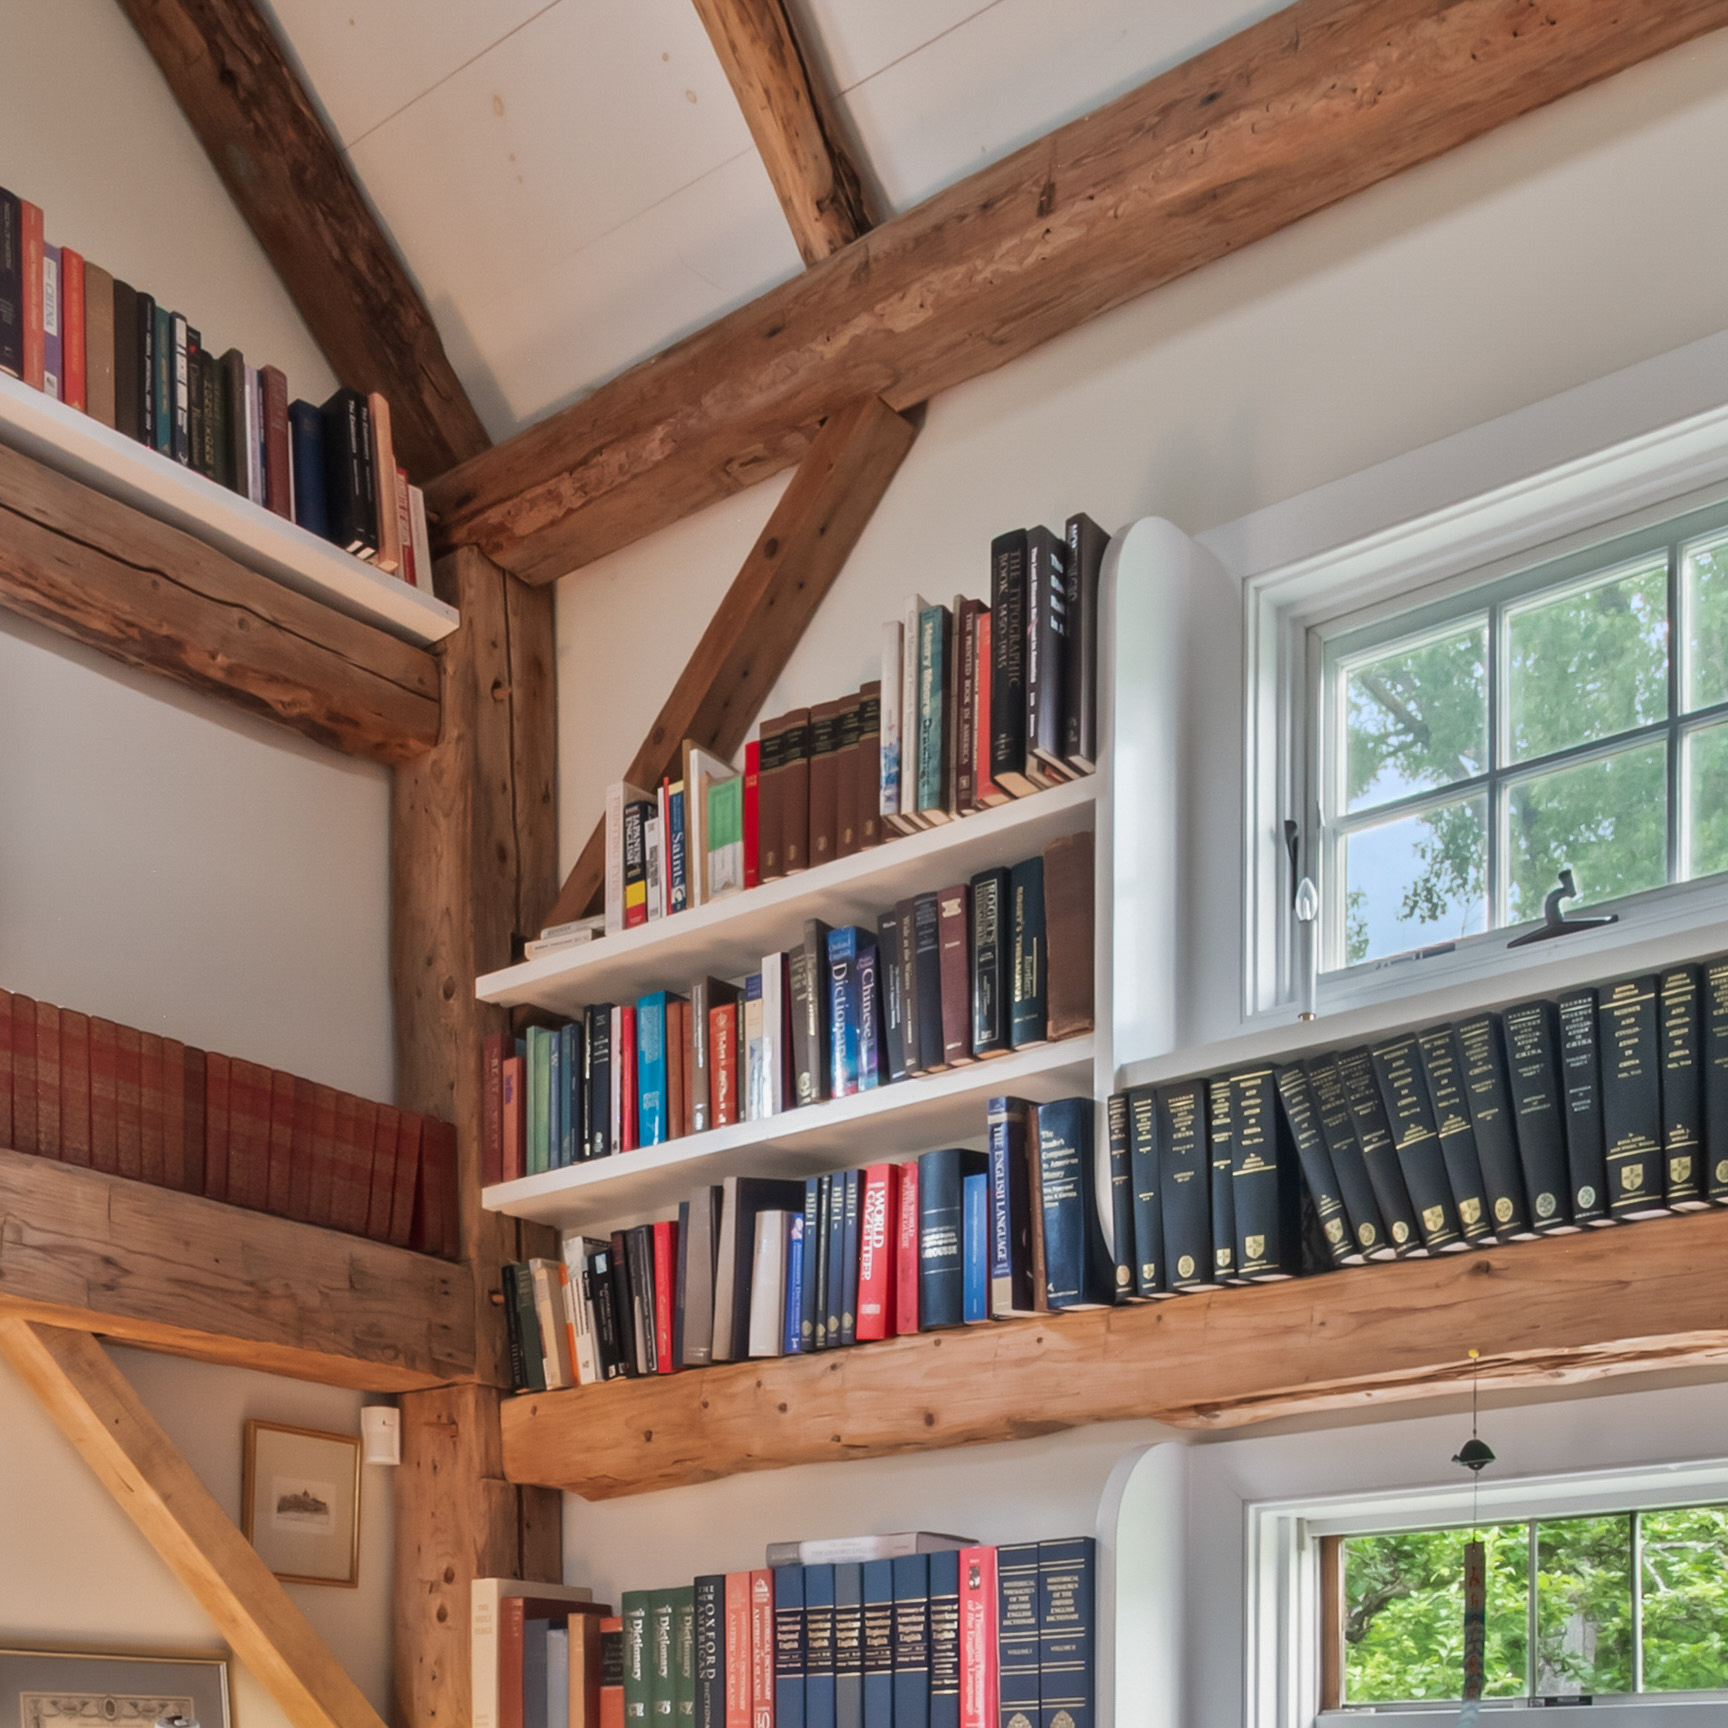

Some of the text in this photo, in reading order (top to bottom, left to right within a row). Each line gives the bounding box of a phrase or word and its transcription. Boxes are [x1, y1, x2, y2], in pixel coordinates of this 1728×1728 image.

[872, 1190, 885, 1248] WORLD
[994, 1124, 1007, 1262] THE ENGLISH LANGUAGE
[861, 1190, 876, 1281] GAZETTEER
[705, 1604, 716, 1680] OXFORD
